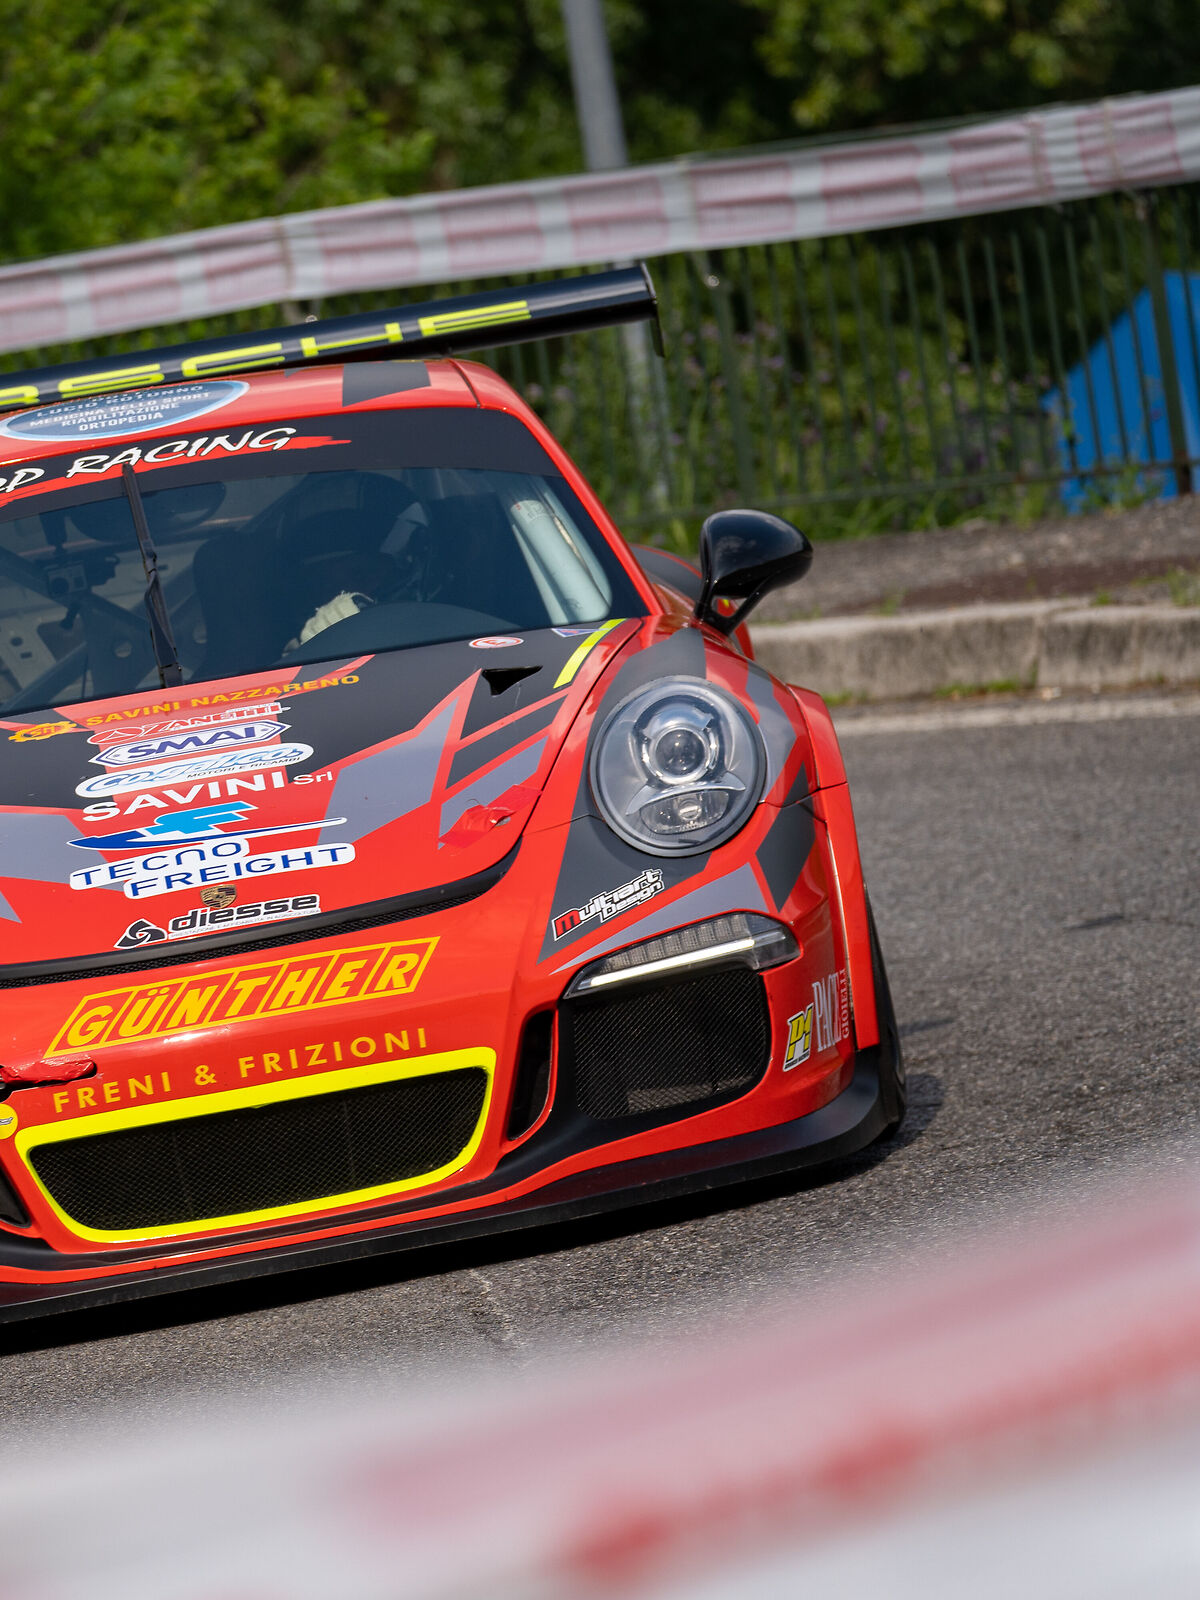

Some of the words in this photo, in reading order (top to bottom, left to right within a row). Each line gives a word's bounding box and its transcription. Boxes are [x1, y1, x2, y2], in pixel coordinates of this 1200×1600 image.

[29, 407, 105, 427] MEDICINA
[109, 400, 158, 415] DELLO
[162, 391, 211, 408] SPORT
[61, 402, 181, 427] RIABILITAZIONE
[78, 411, 164, 431] ORTOPEDIA
[66, 427, 297, 478] RACING
[86, 702, 181, 726] SAVINI
[191, 675, 360, 707] NAZZARENO
[127, 727, 256, 759] SMAI
[187, 767, 236, 779] MOTORI
[249, 757, 300, 769] RICAMBI
[82, 771, 286, 822] SAVINI
[293, 771, 334, 786] Srl
[130, 846, 349, 897] FREIGHT
[171, 895, 318, 932] diesse
[602, 881, 663, 919] Design
[66, 953, 420, 1047] GÜNTHER
[53, 1070, 171, 1115] FRENI
[194, 1064, 218, 1086] &
[239, 1027, 428, 1080] FRIZIONI
